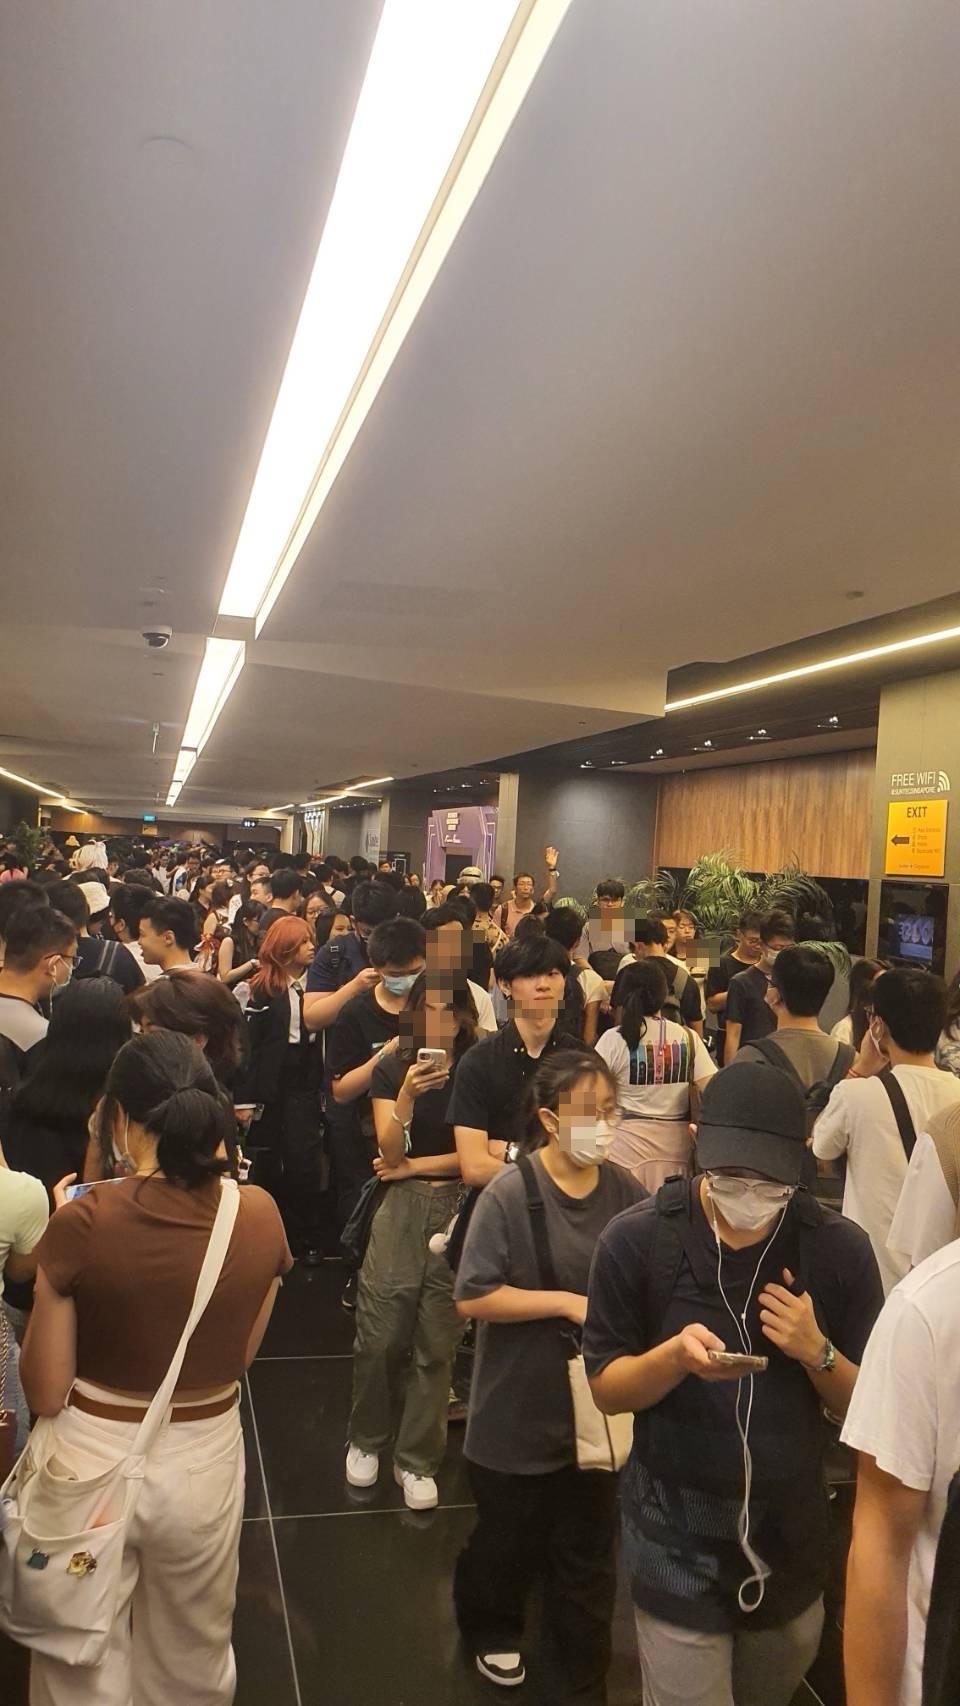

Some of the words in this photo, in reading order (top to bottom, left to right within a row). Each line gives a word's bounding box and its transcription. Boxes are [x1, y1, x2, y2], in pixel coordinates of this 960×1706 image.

[891, 773, 914, 787] FREE
[916, 771, 936, 785] WIFI
[906, 806, 928, 818] EXIT
